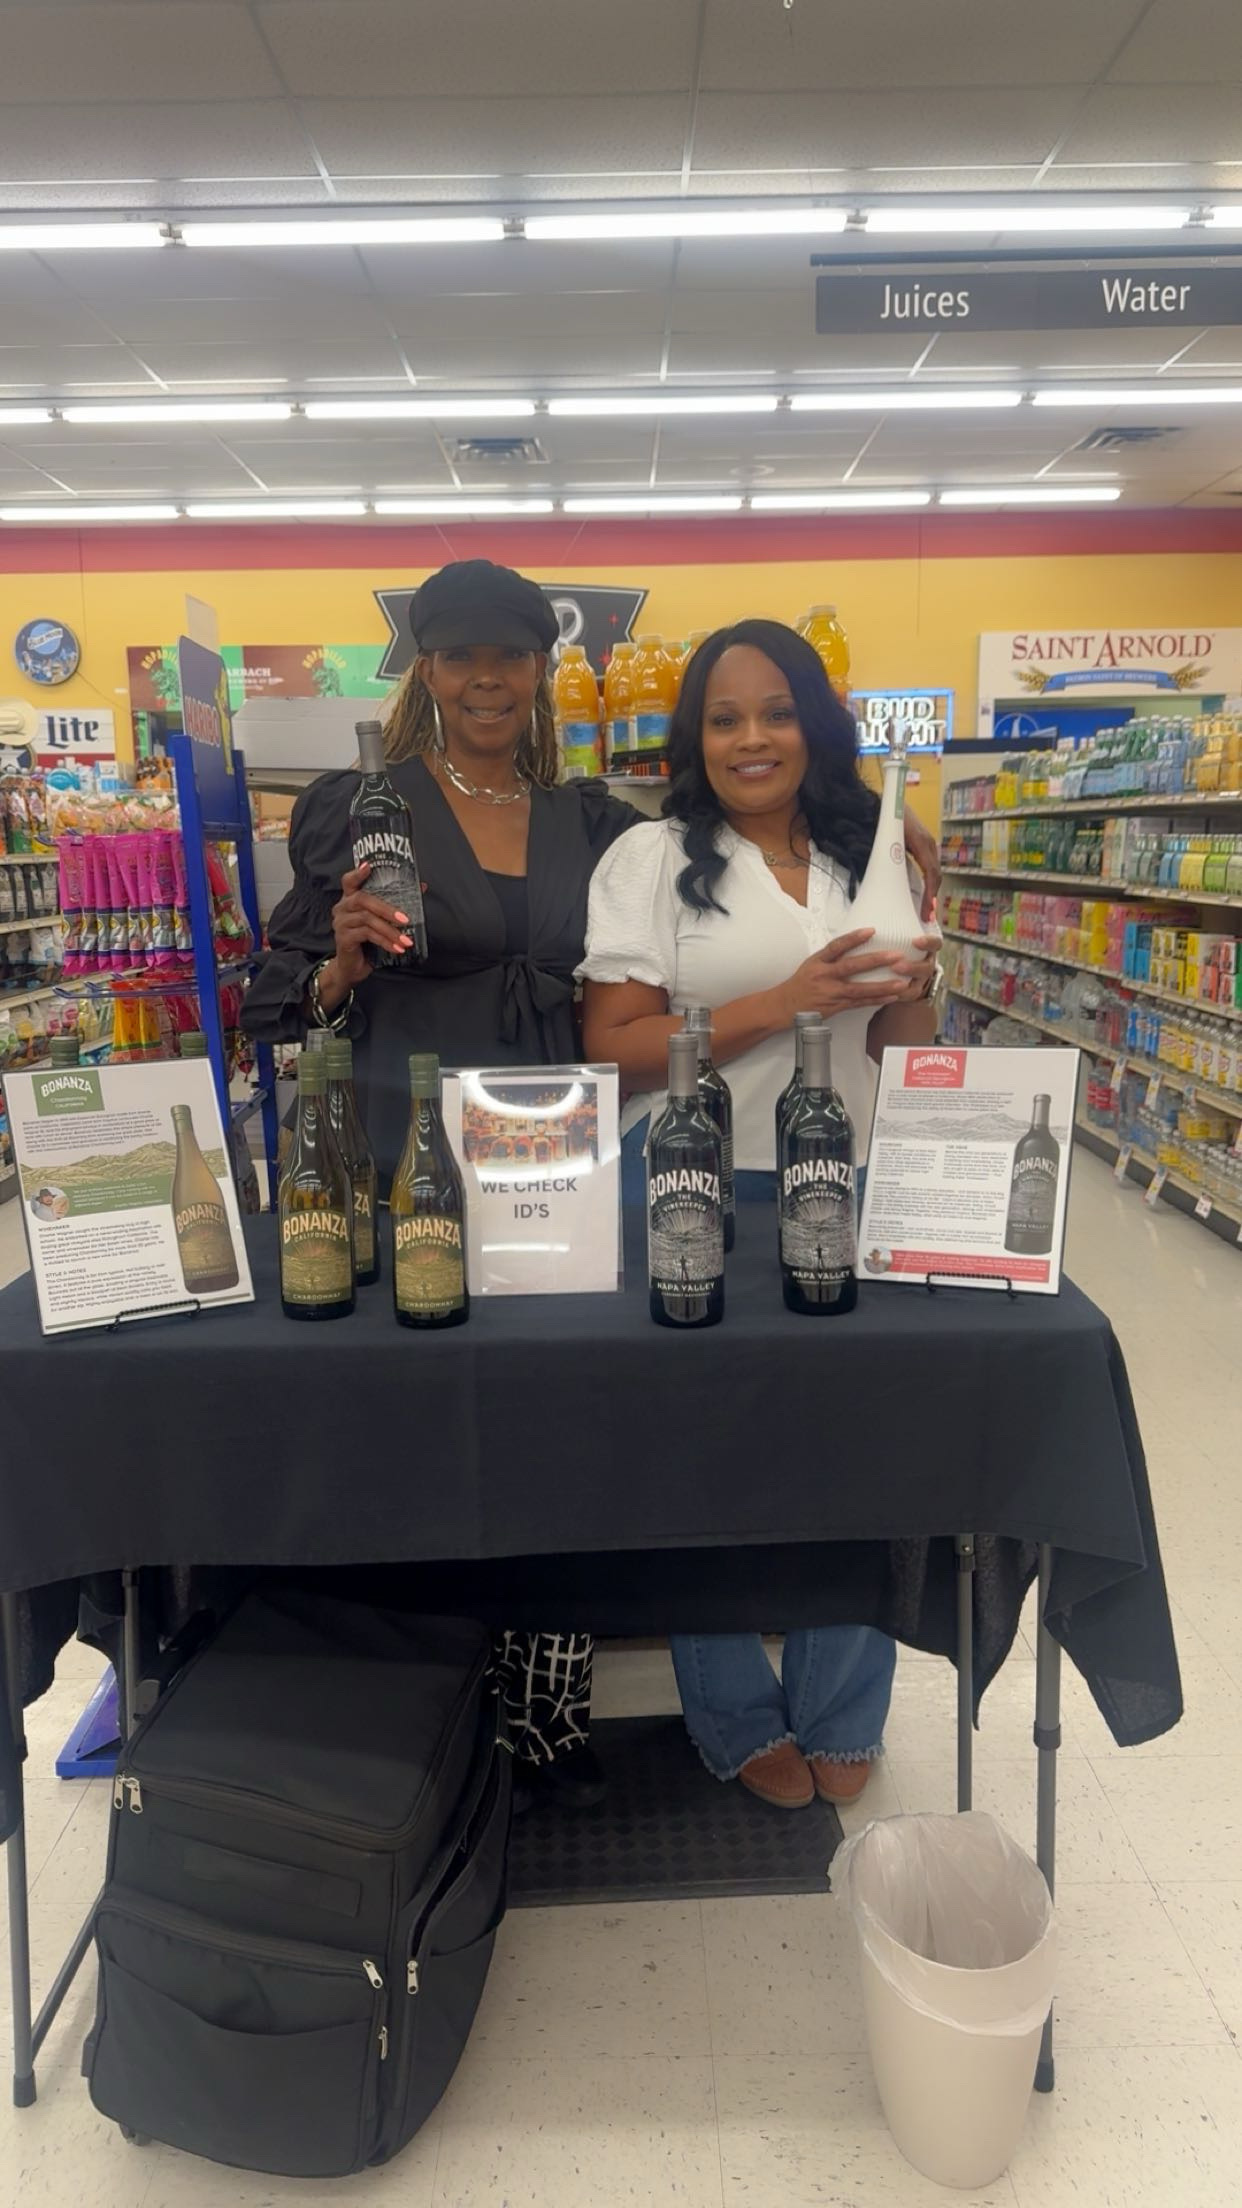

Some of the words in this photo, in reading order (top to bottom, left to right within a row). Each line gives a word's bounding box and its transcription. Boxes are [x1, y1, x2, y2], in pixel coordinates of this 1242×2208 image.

[880, 284, 970, 318] Juices
[1102, 277, 1191, 313] Water
[141, 649, 178, 670] HOPADIL
[1012, 634, 1095, 660] SAINT
[1093, 632, 1213, 668] ARNOLD
[226, 667, 271, 677] ARBACH
[867, 697, 934, 722] BUD
[45, 716, 99, 749] Lite
[353, 832, 414, 870] BONANZA
[912, 1053, 958, 1072] BONANZA
[40, 1075, 93, 1097] BONANZA
[784, 1159, 854, 1196] BONANZA
[1013, 1157, 1058, 1182] BONANZA
[481, 1181, 509, 1194] WE
[513, 1177, 577, 1193] CHECK
[650, 1168, 721, 1206] BONANZA
[799, 1190, 843, 1202] VINEKEEPER
[514, 1203, 550, 1219] ID'S
[663, 1202, 707, 1212] VINEKEEPER
[176, 1203, 225, 1234] BONANZA
[283, 1211, 350, 1244] BONANZA
[294, 1232, 337, 1243] CALIFORNIA
[396, 1218, 462, 1250] BONANZA
[406, 1238, 450, 1249] CALIFORNIA
[792, 1270, 816, 1280] NAPA
[817, 1270, 850, 1280] VALLEY
[657, 1282, 680, 1291] NAPA
[681, 1282, 715, 1292] VALLEY
